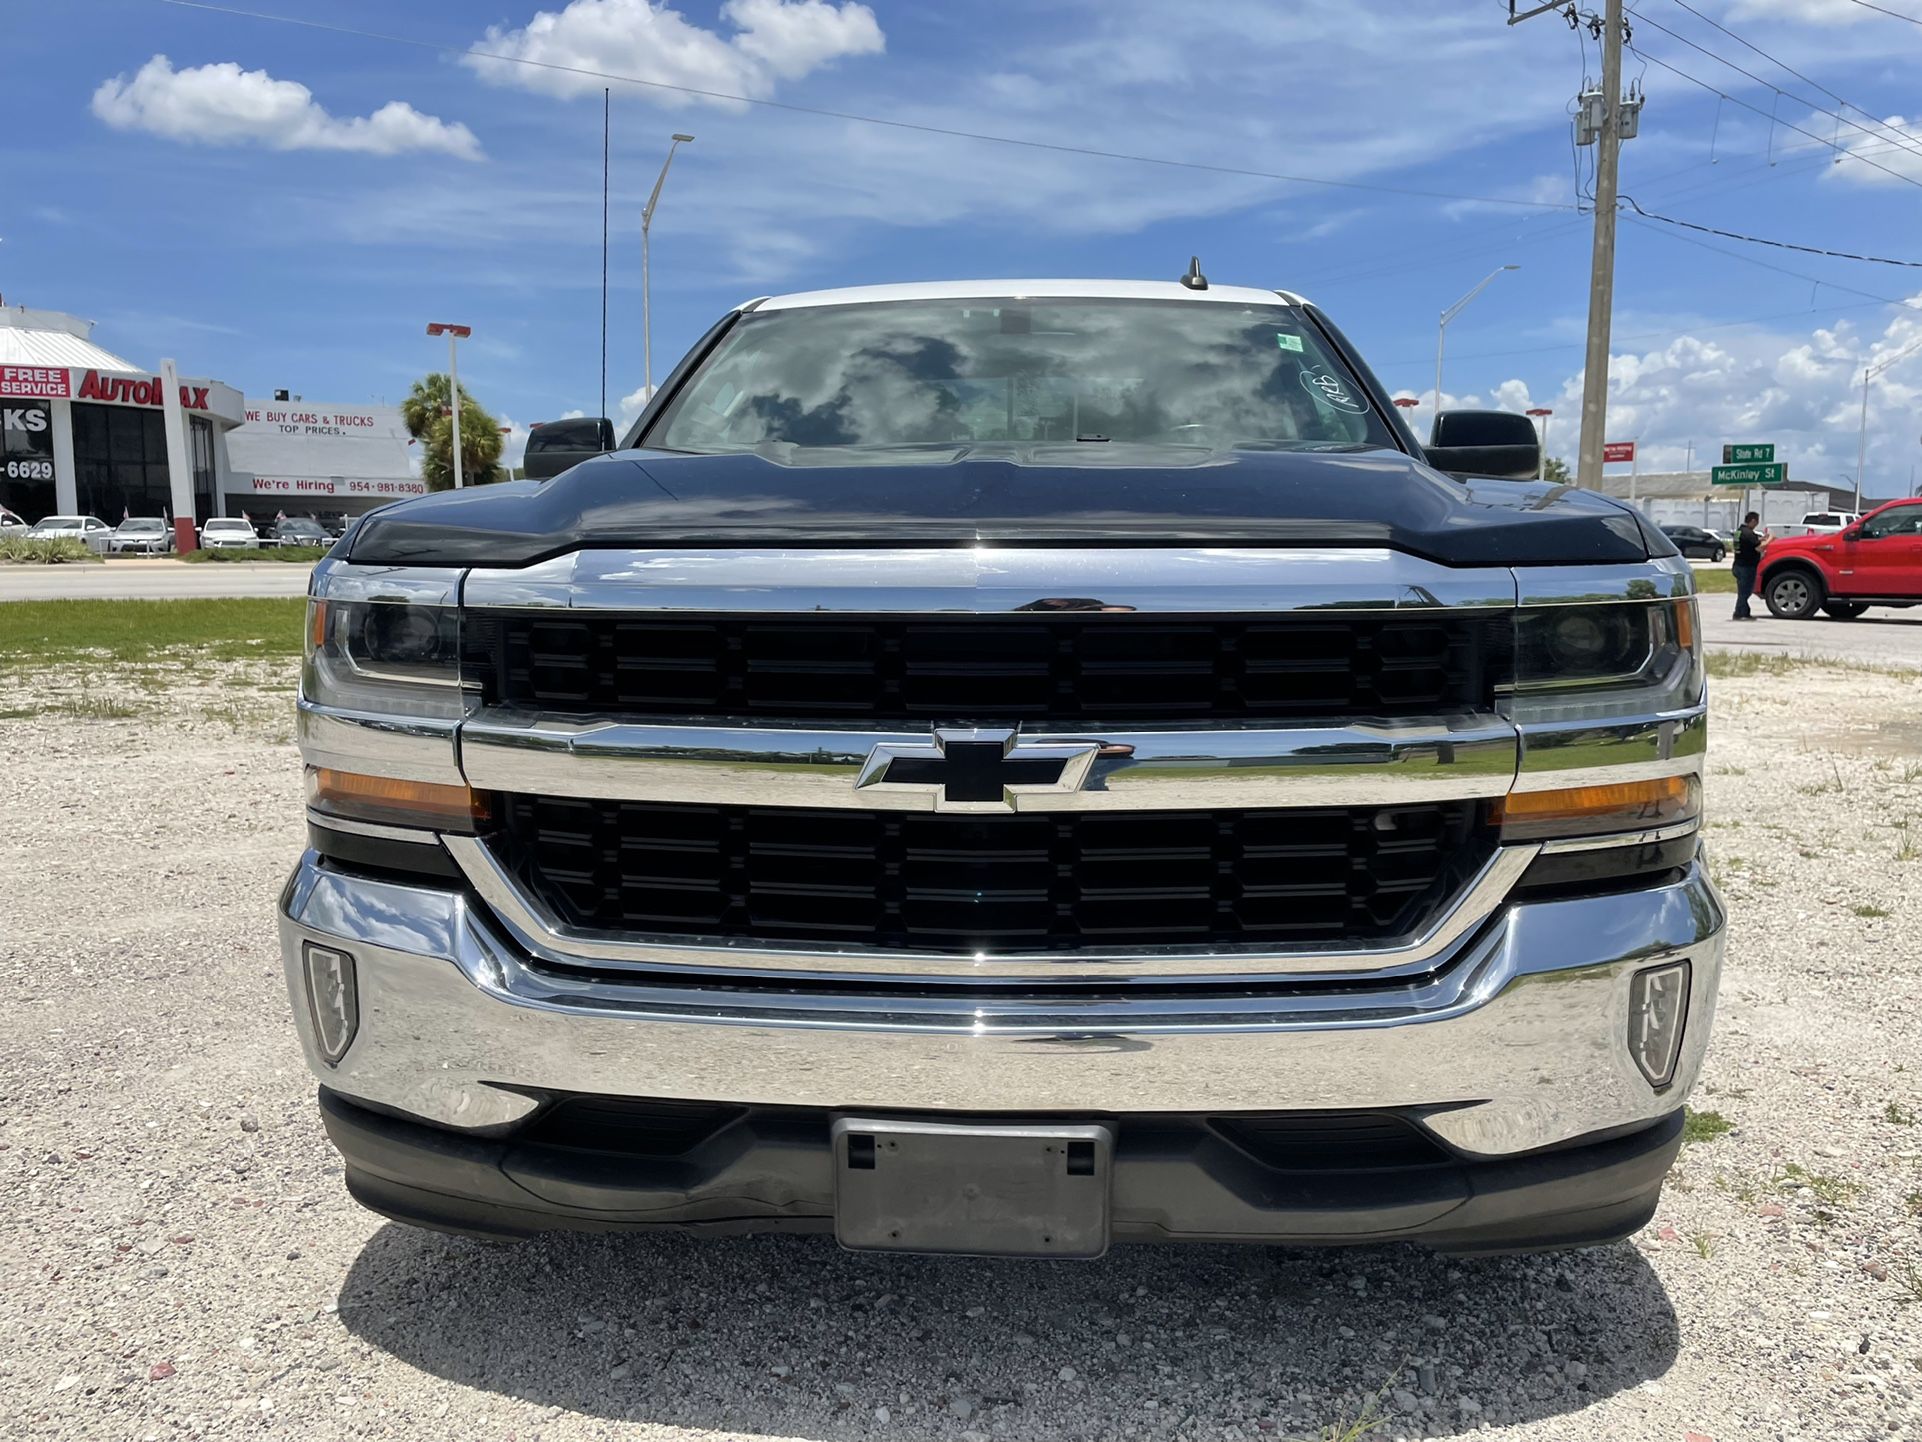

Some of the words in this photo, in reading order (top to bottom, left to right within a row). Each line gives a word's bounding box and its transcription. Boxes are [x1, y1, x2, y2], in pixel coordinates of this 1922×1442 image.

[4, 368, 61, 382] FREE
[1, 382, 67, 395] SERVICE
[0, 409, 47, 431] KS
[245, 411, 260, 421] WE
[267, 412, 287, 423] BUY
[291, 413, 318, 424] CARS
[322, 416, 330, 425] &
[333, 415, 374, 427] TRUCKS
[279, 424, 299, 434] TOP
[1754, 448, 1763, 459] Rd
[1765, 448, 1770, 458] 7
[1717, 469, 1760, 481] McKinley
[1765, 468, 1775, 478] St
[252, 479, 289, 490] We're
[296, 480, 335, 494] Hiring
